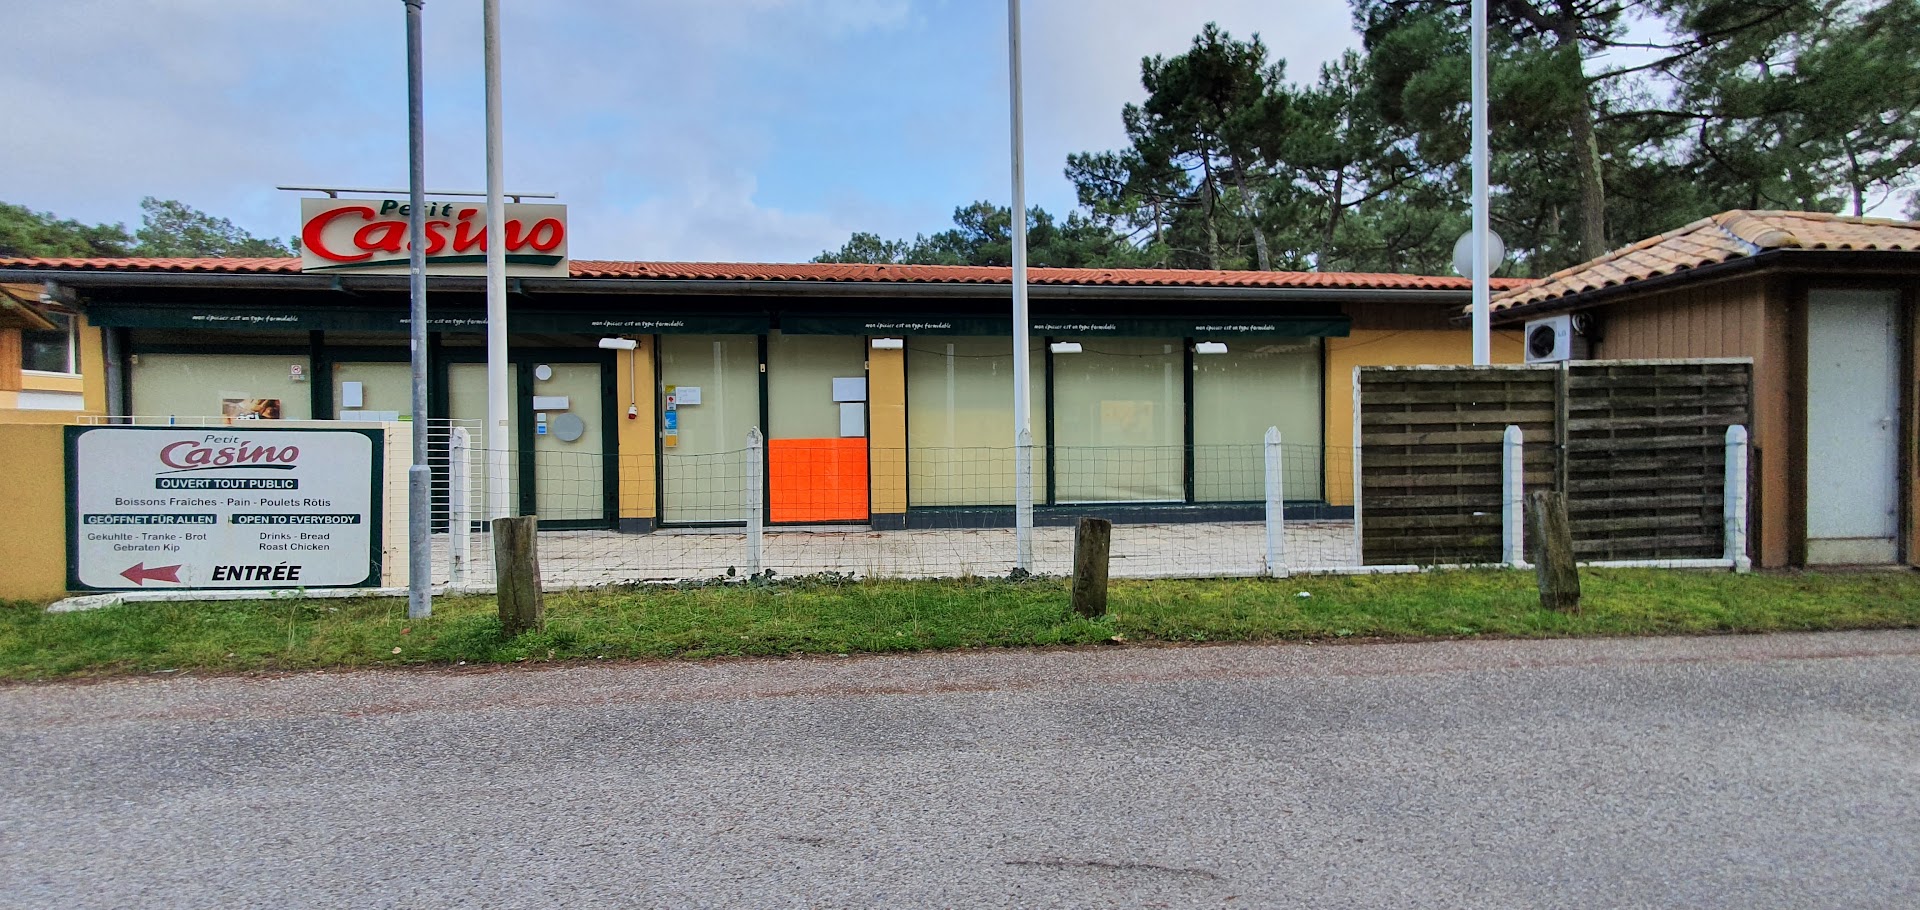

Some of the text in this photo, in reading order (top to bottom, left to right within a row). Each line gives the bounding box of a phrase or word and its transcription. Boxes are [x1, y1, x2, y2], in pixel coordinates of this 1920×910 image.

[379, 199, 453, 217] Peit
[250, 316, 264, 324] type
[204, 434, 240, 444] Petit
[160, 440, 300, 469] Casino
[160, 479, 294, 488] OUVERT TOUT PUBLIC
[115, 497, 166, 506] Boissons
[169, 497, 217, 506] Fraîches
[227, 498, 250, 506] Pain
[260, 498, 300, 507] Poulets
[303, 498, 331, 507] Rôtis
[88, 514, 213, 524] GEÖFFNET FÜR ALLEN
[238, 515, 355, 524] OPEN TO EVERYBODY
[87, 532, 133, 541] Gekuhlte
[142, 532, 176, 541] Tranke
[185, 532, 207, 541] Brot
[260, 532, 292, 540] Drinks
[113, 543, 180, 553] Gebraten Kip
[290, 543, 330, 551] Chicken
[212, 561, 302, 581] ENTRÉE
